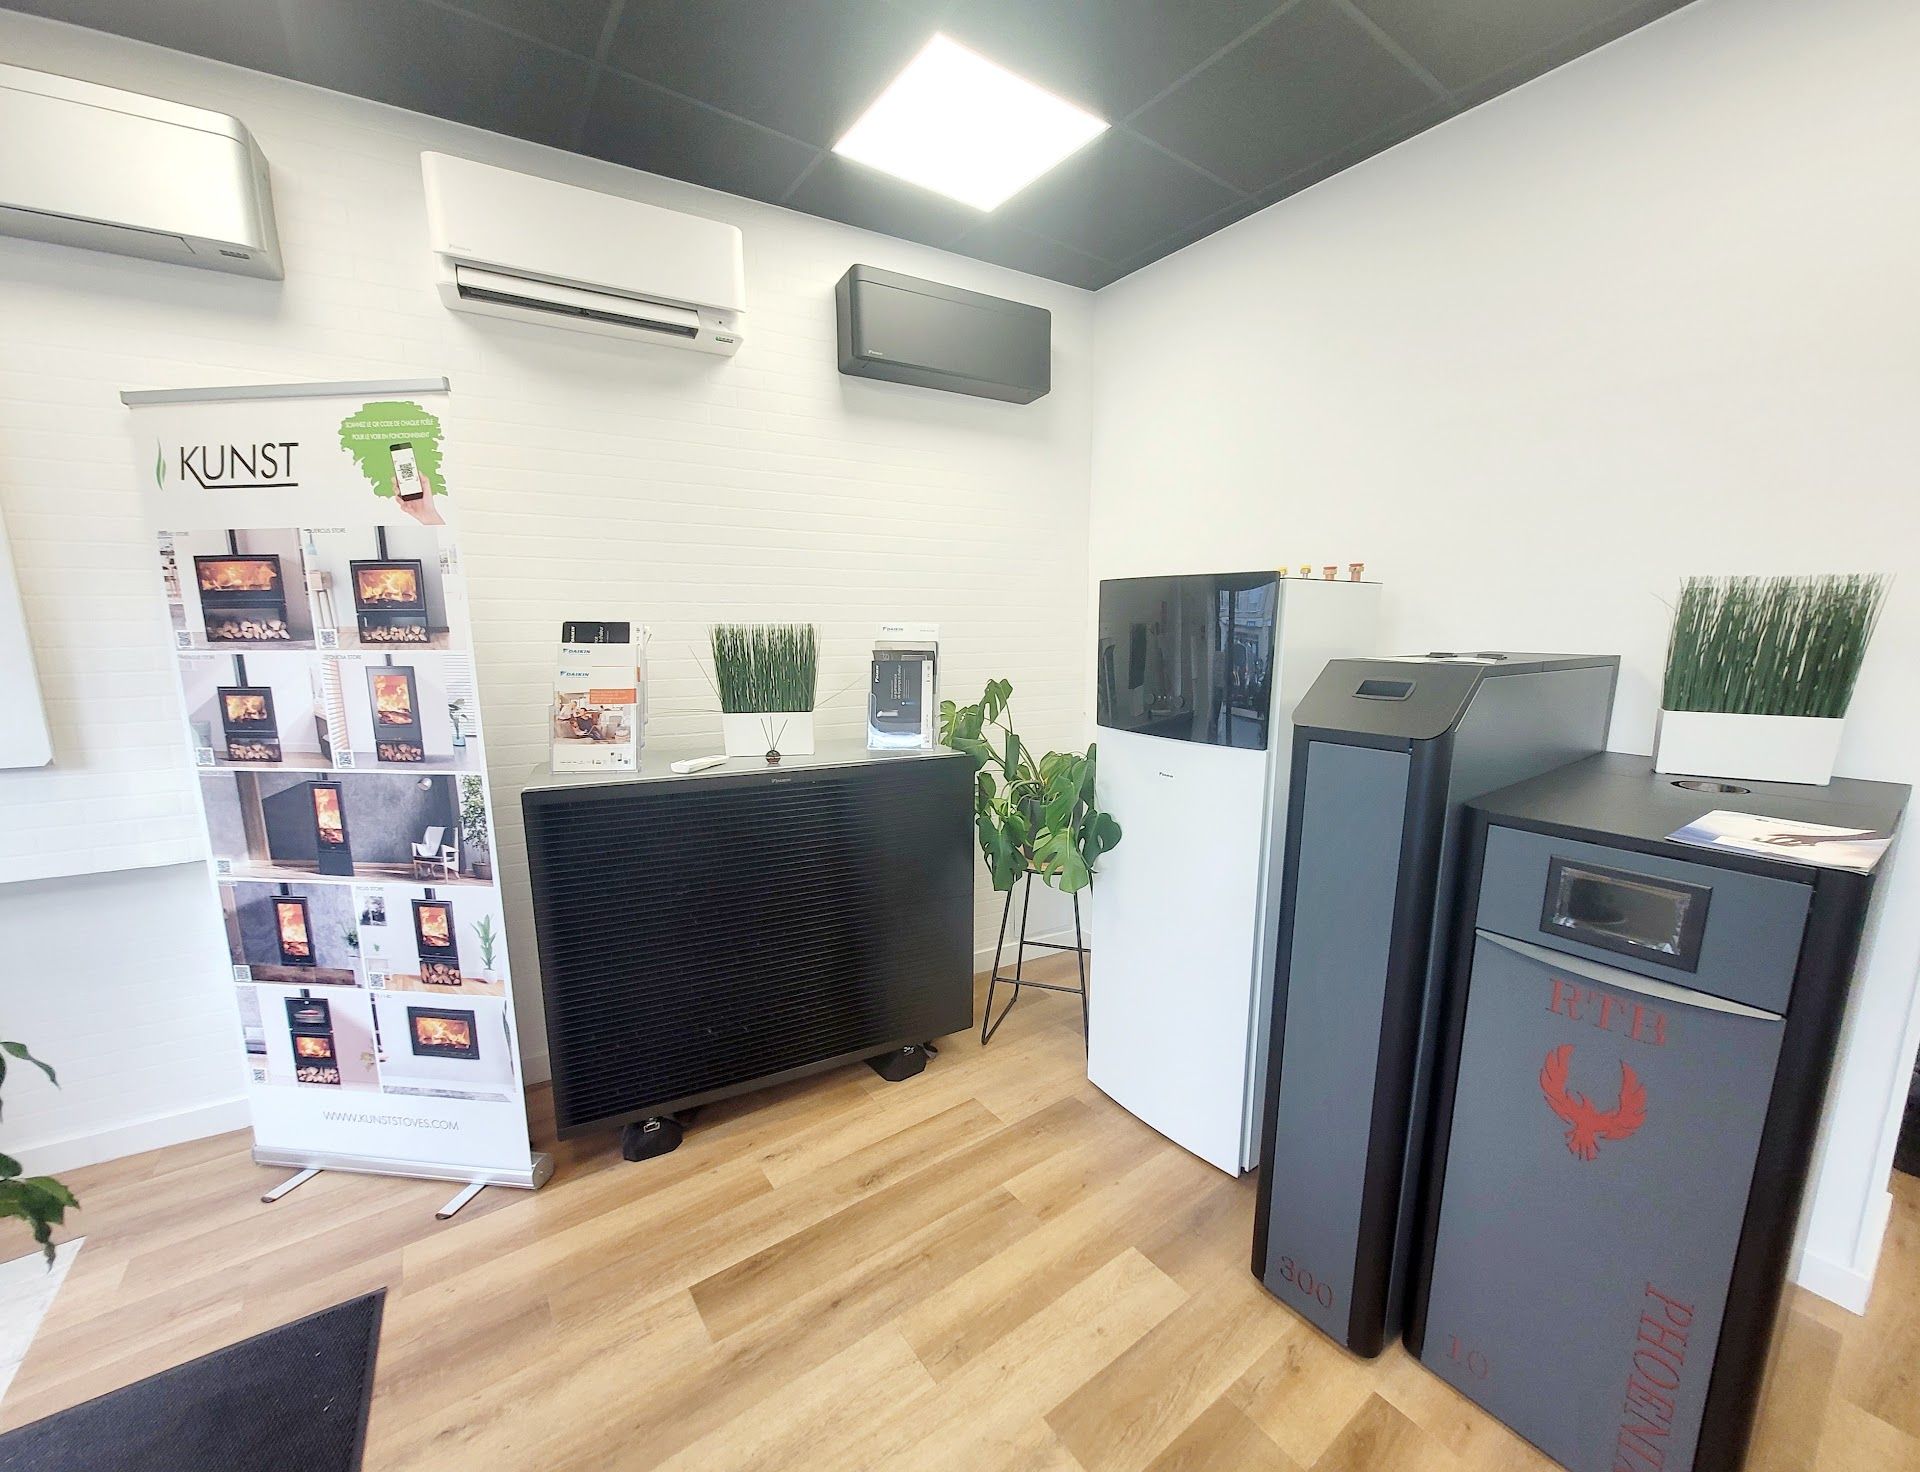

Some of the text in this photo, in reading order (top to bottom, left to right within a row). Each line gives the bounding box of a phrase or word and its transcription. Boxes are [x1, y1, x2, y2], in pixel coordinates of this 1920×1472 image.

[180, 442, 299, 485] KUNST
[1545, 977, 1667, 1046] RTB
[322, 1111, 460, 1131] WWW.KUNSTSTOVES.COM
[1280, 1256, 1333, 1308] 300
[1447, 1332, 1488, 1379] 10
[1611, 1281, 1695, 1472] PHOENI
